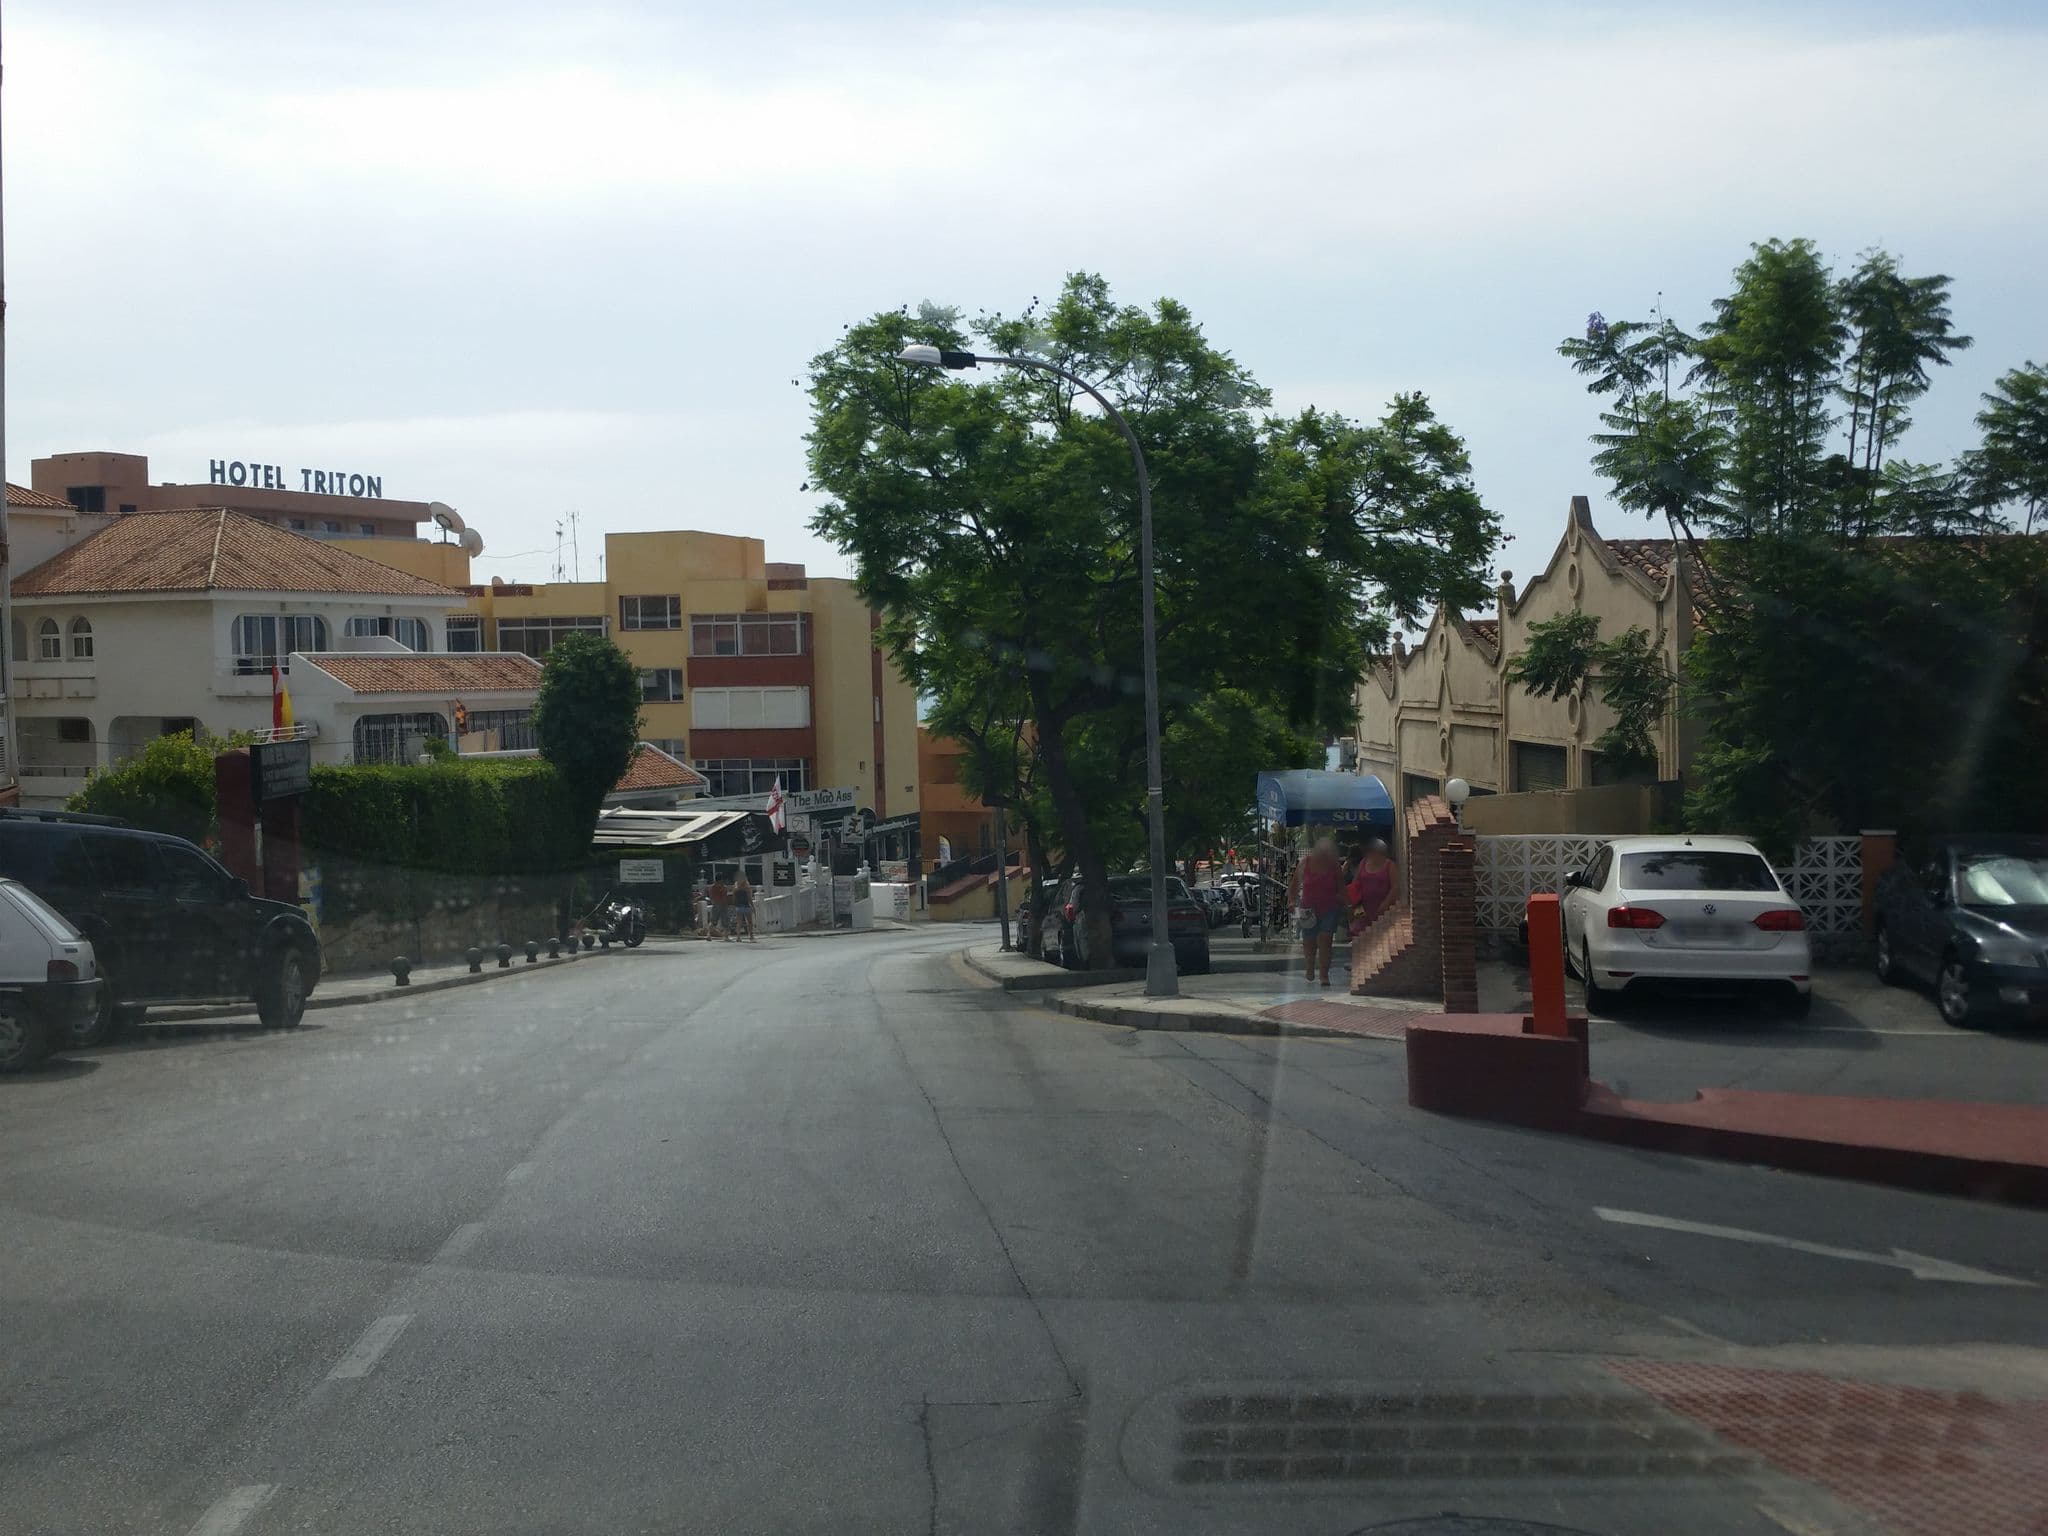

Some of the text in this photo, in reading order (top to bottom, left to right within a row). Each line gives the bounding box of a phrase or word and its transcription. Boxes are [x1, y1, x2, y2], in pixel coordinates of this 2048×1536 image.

[210, 459, 382, 498] HOTEL TRITON
[792, 794, 811, 808] The
[814, 791, 834, 805] Mad
[1332, 810, 1372, 822] SUR
